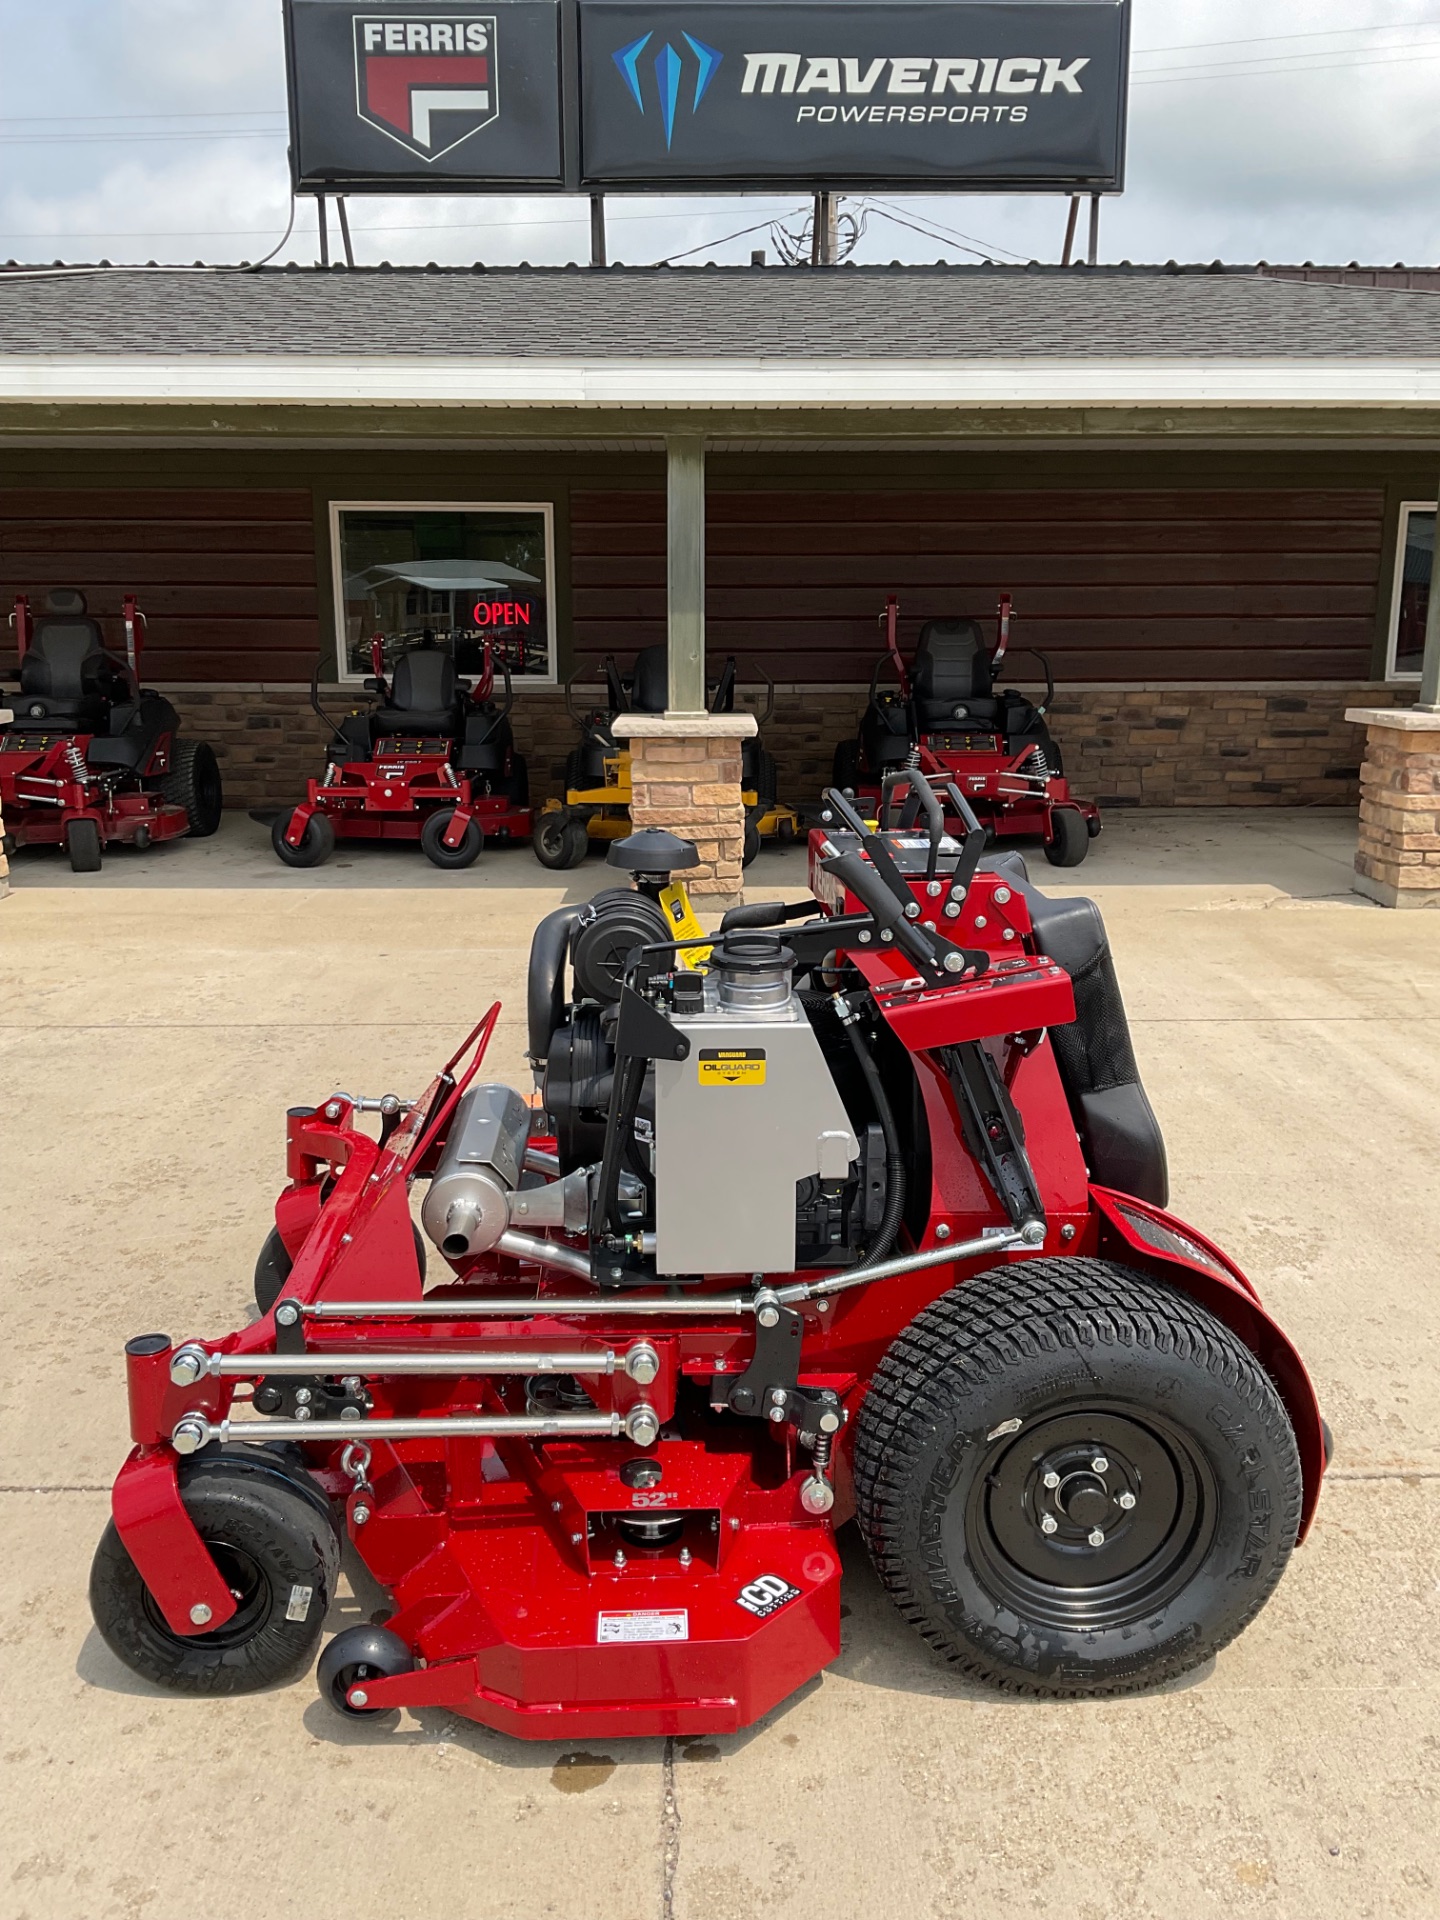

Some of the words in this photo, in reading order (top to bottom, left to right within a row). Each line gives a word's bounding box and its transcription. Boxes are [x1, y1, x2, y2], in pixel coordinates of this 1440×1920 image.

[364, 23, 488, 51] FERRIS
[741, 52, 1092, 93] MAVERICK
[796, 106, 1029, 123] POWERSPORTS
[474, 602, 530, 625] OPEN
[631, 1492, 679, 1508] 52"
[919, 1431, 977, 1604] MASTER
[756, 1588, 801, 1617] CUTTING
